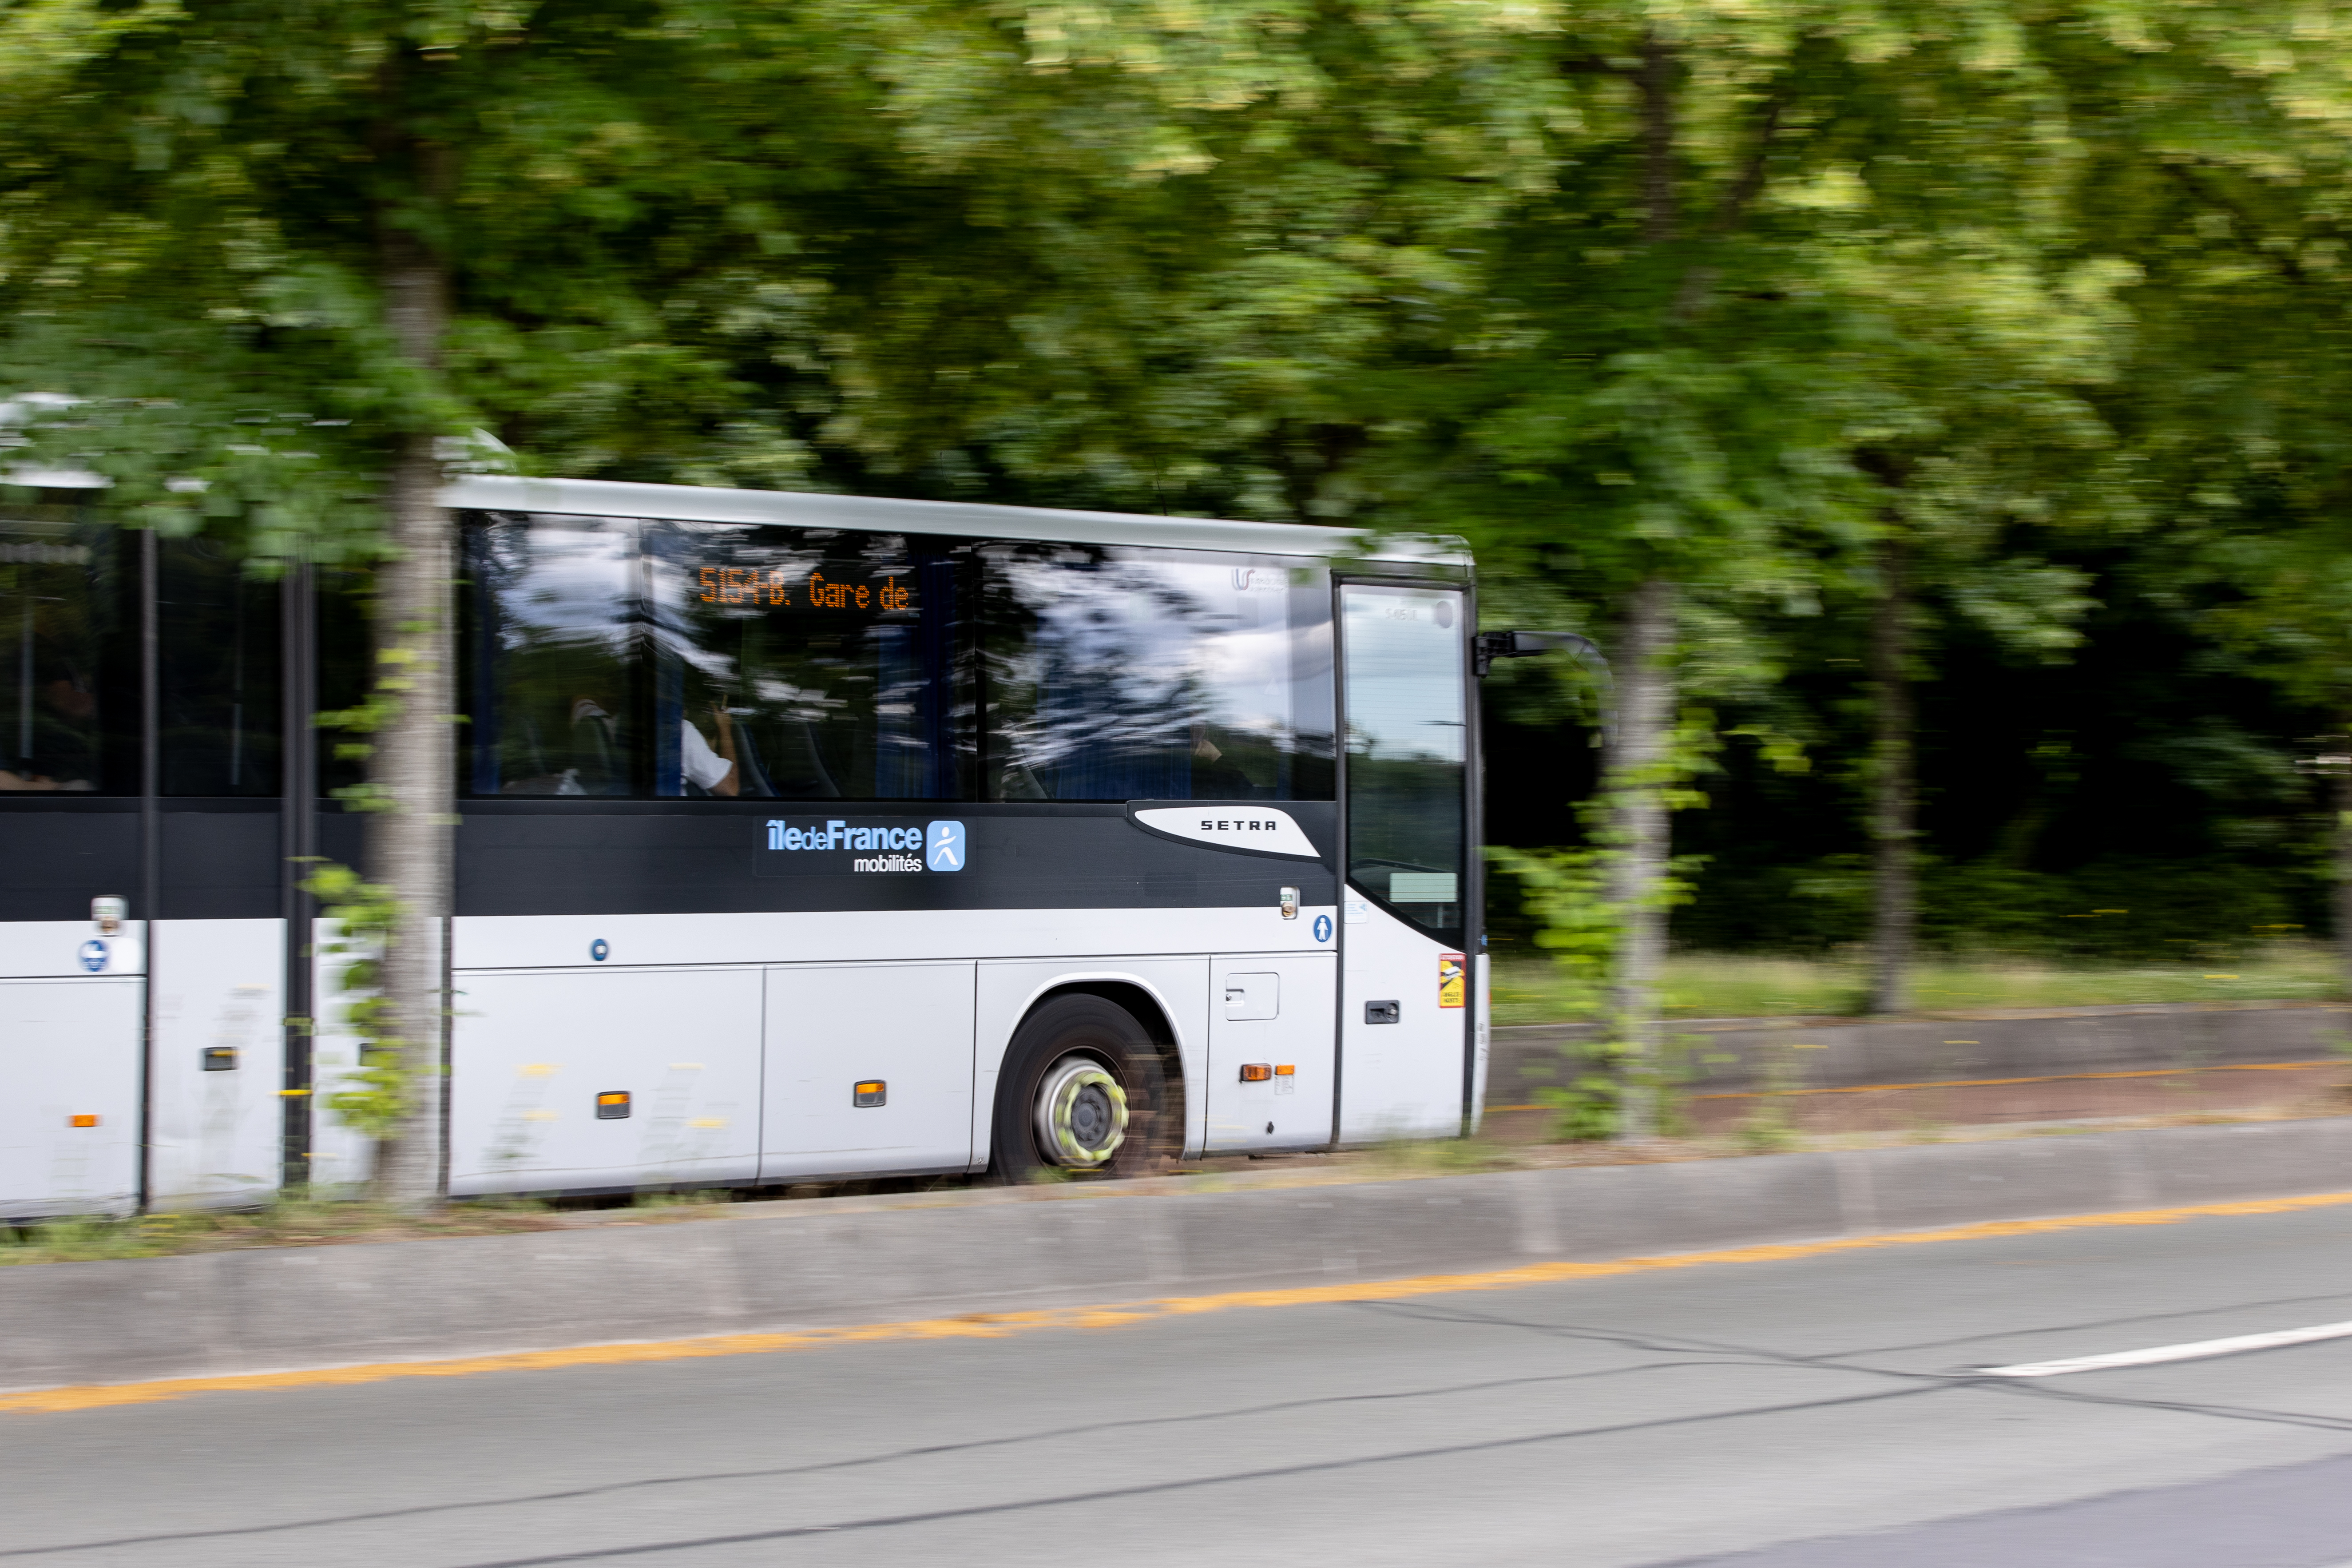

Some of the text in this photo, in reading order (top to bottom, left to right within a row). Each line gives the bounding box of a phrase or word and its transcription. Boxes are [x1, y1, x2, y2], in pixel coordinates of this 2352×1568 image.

[809, 573, 870, 608] Gare
[879, 576, 909, 610] de
[1201, 821, 1276, 830] SETRA
[854, 853, 922, 872] mobilités
